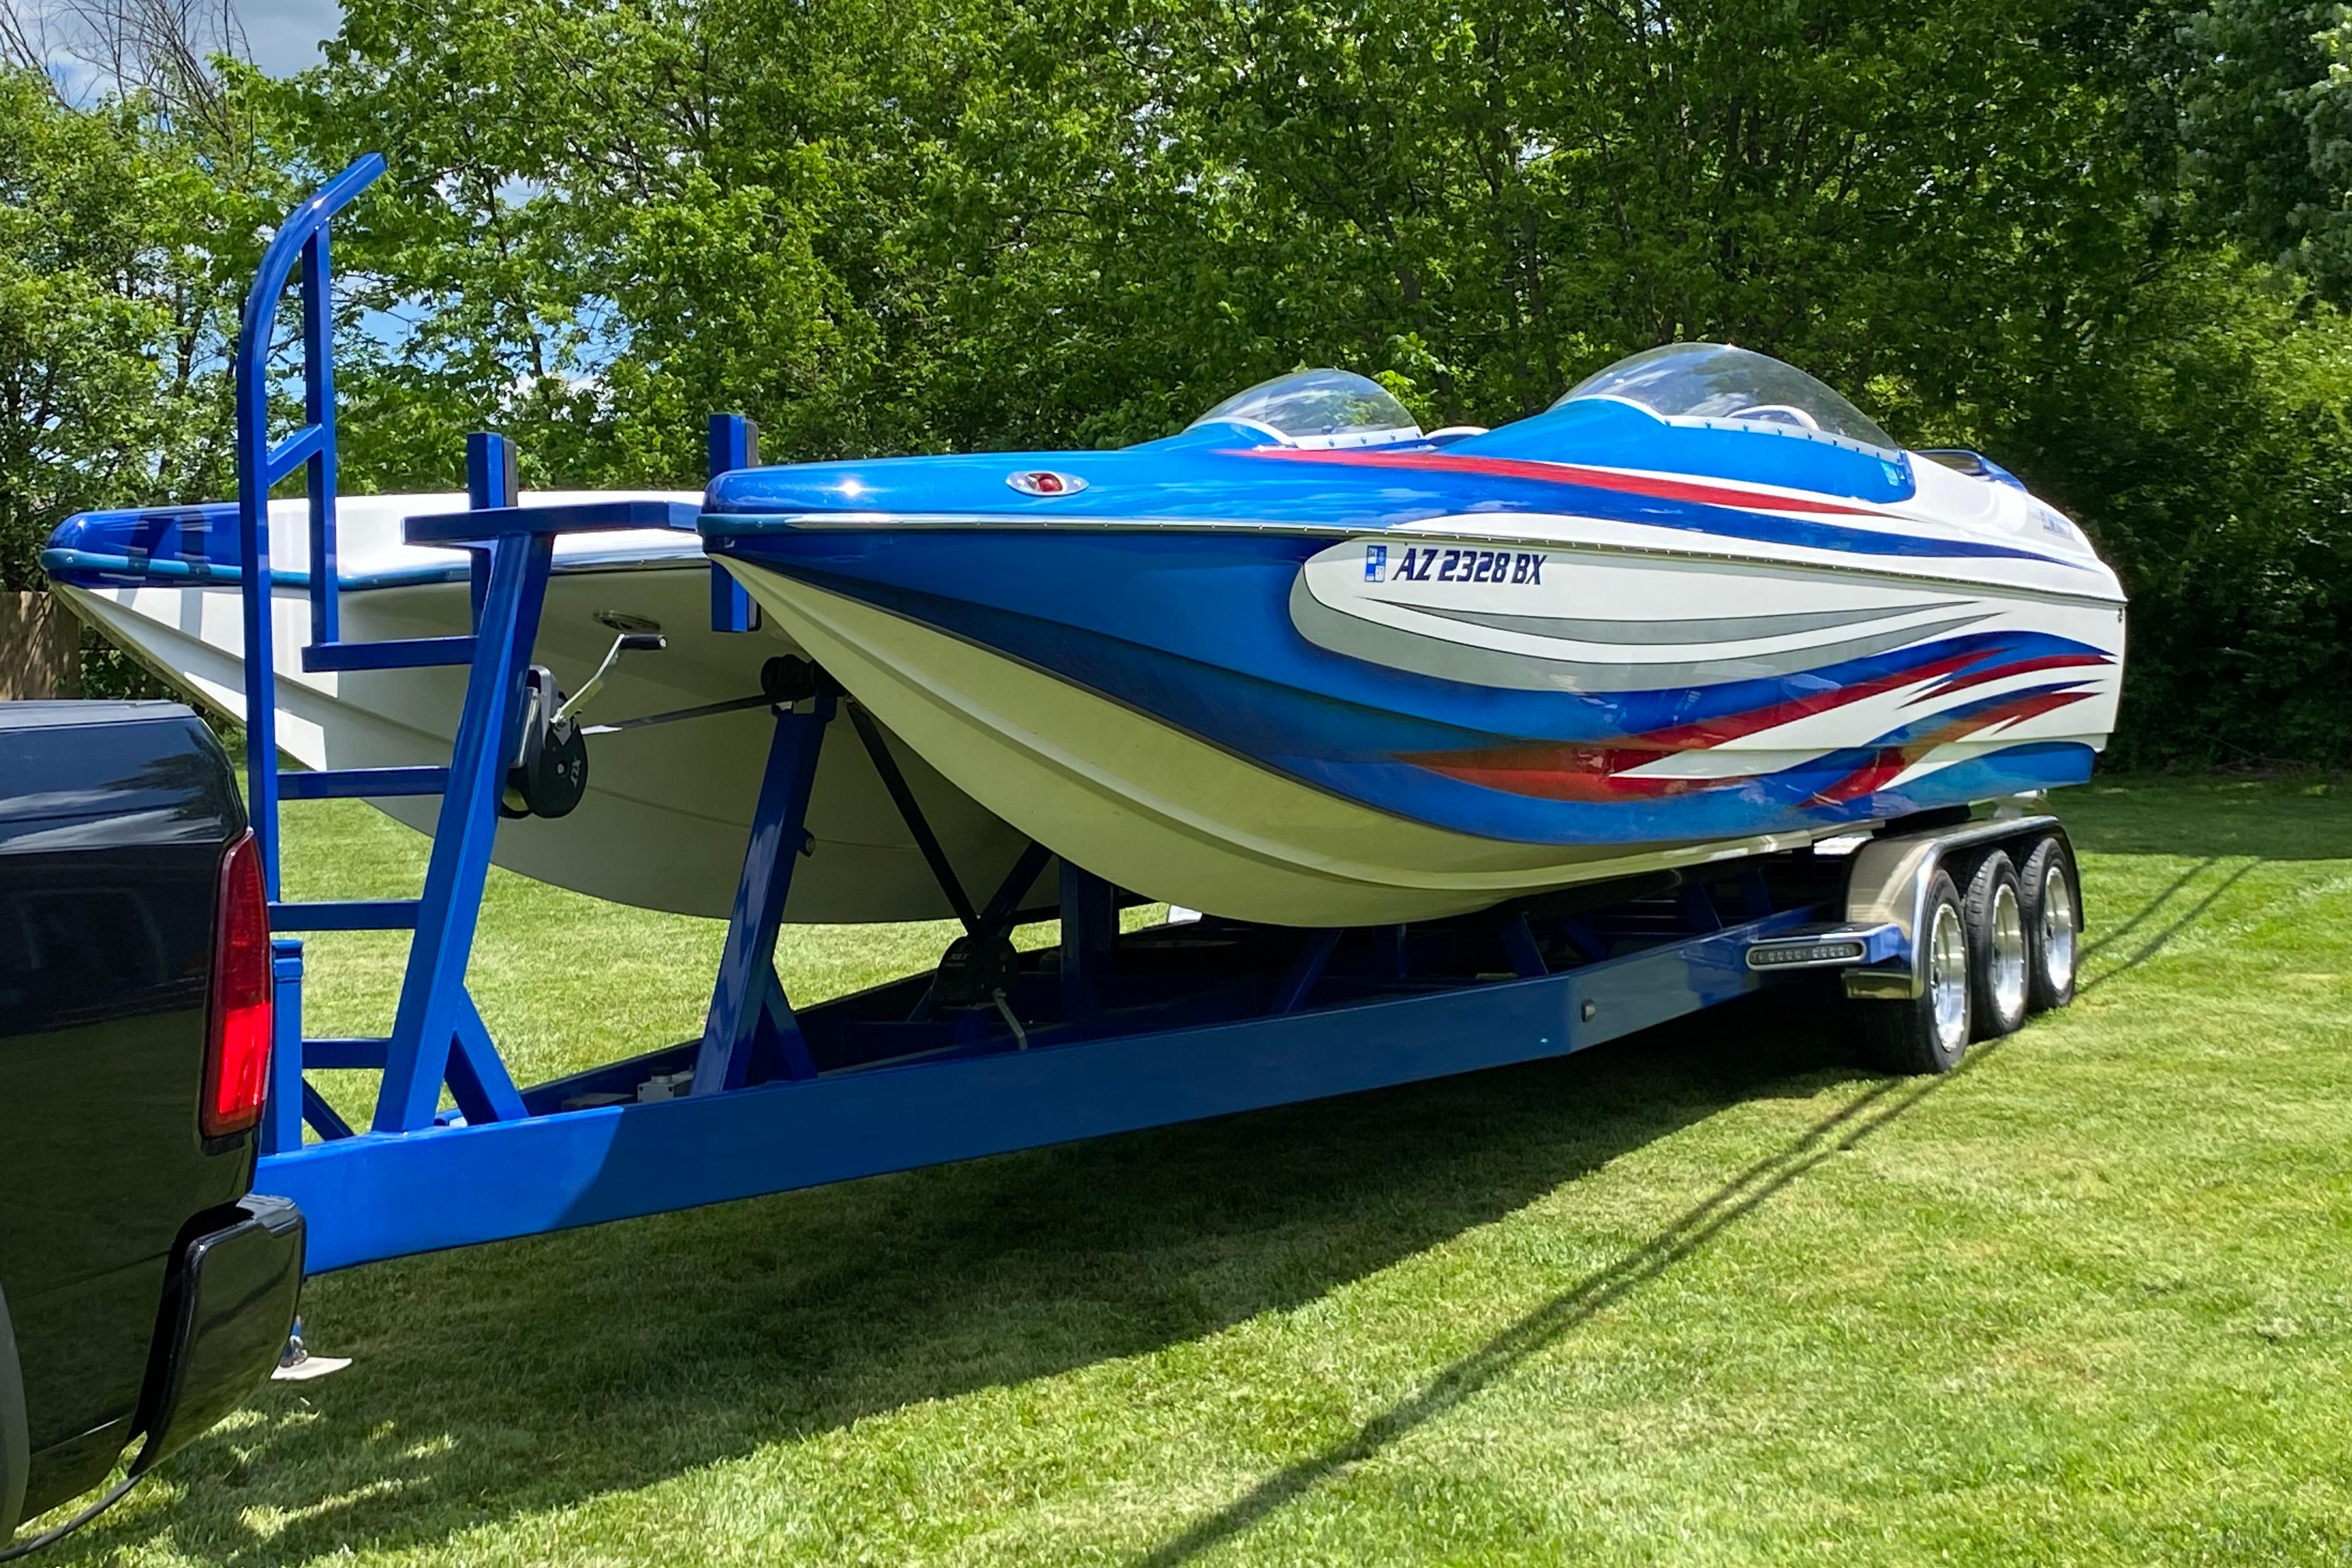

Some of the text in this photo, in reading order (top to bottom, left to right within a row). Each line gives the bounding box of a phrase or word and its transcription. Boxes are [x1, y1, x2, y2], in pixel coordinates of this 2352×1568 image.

[1391, 548, 1548, 585] AZ 2328 BX
